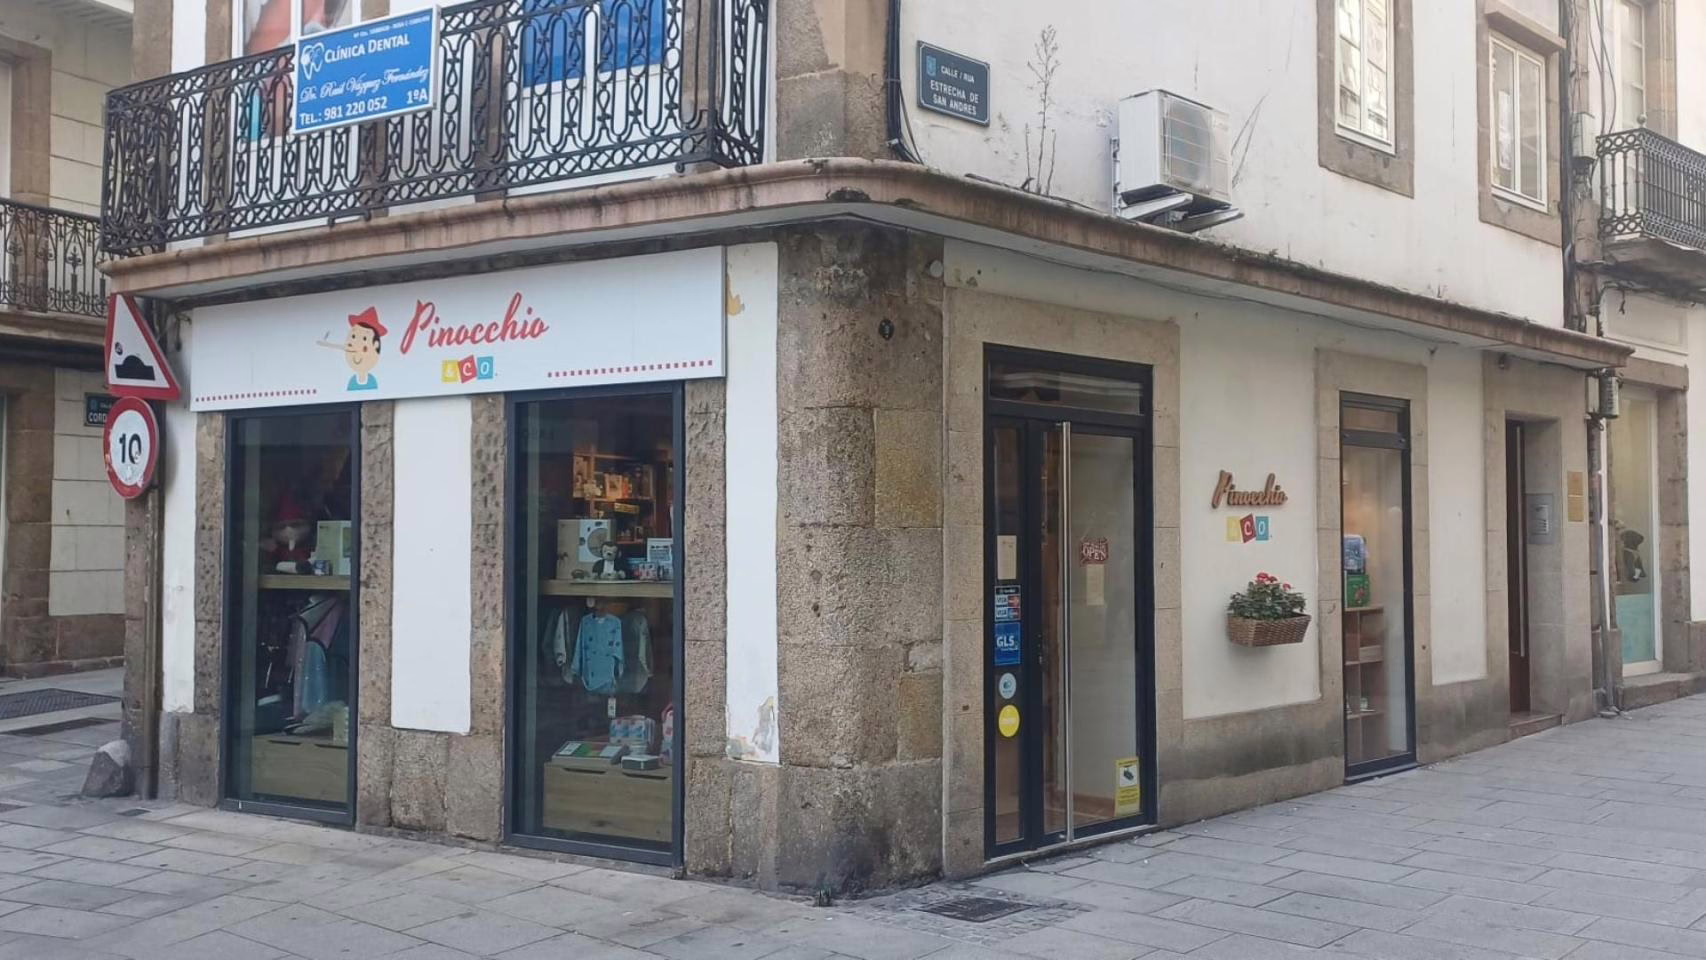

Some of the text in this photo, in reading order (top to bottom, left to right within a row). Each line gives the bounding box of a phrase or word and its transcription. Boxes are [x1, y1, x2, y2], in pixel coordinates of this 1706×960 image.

[324, 33, 410, 64] CLÍNICA DENTAL
[940, 65, 958, 78] CALLE
[930, 79, 979, 104] ESTRECHA DE
[324, 106, 343, 121] 981
[346, 101, 366, 117] 220
[367, 96, 388, 112] 052
[933, 94, 977, 115] SAN ANDRES
[400, 291, 551, 355] Pinocchio
[119, 433, 142, 465] 10
[1211, 470, 1288, 509] Pinocchio
[1082, 544, 1107, 560] OPEN
[996, 635, 1015, 648] GLS
